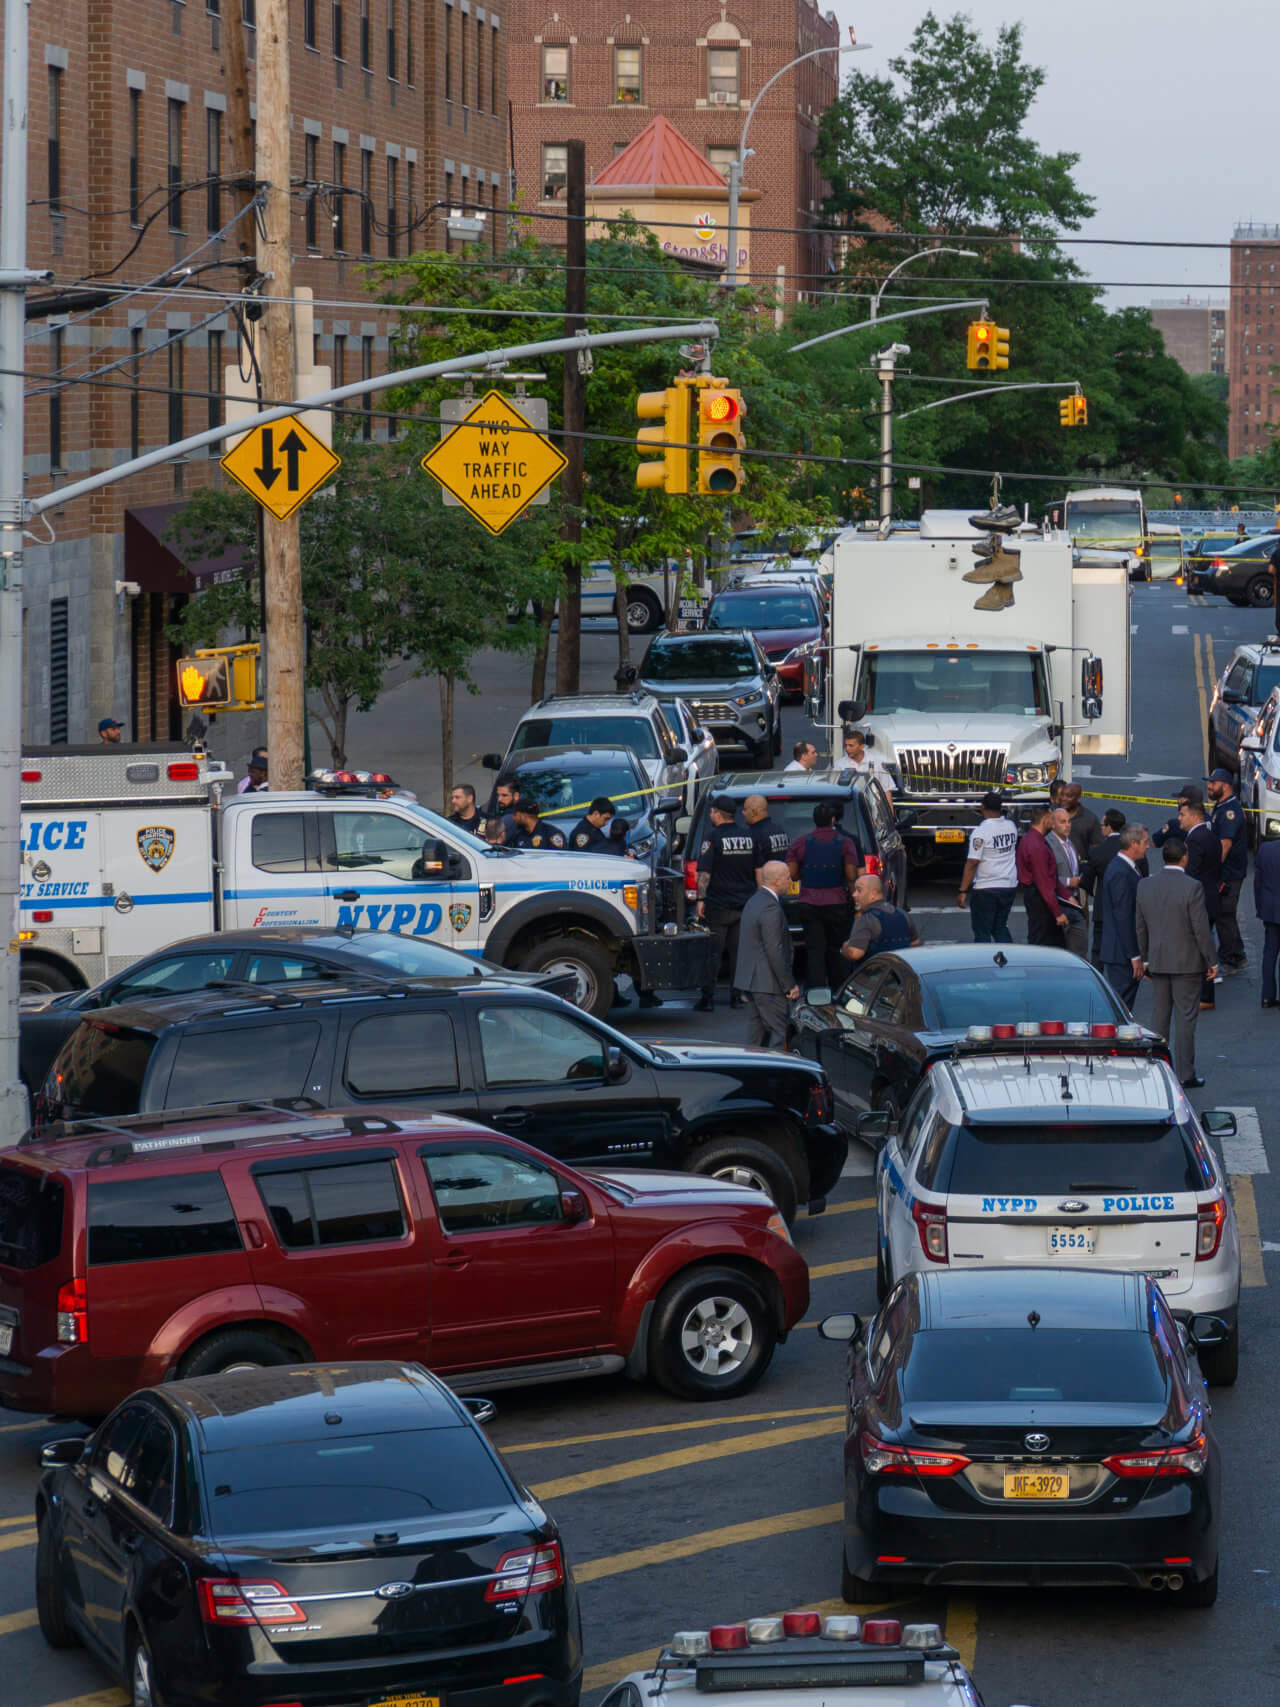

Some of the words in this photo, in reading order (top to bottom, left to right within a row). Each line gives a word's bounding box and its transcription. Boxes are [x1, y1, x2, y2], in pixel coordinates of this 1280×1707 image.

[663, 242, 748, 265] Stop&Shp
[478, 420, 510, 436] TWO
[479, 441, 510, 457] WAY
[463, 462, 527, 478] TRAFFIC
[470, 484, 522, 499] AHEAD
[20, 821, 88, 851] ICE
[721, 836, 753, 850] NYPD
[992, 833, 1016, 849] NYPD
[37, 882, 90, 897] SERVICE
[568, 880, 609, 890] POLICE
[335, 903, 443, 936] NYPD
[134, 1135, 201, 1151] PATHFINDER
[981, 1197, 1038, 1213] NYPD
[1103, 1196, 1175, 1212] POLICE
[1051, 1234, 1085, 1248] 5552
